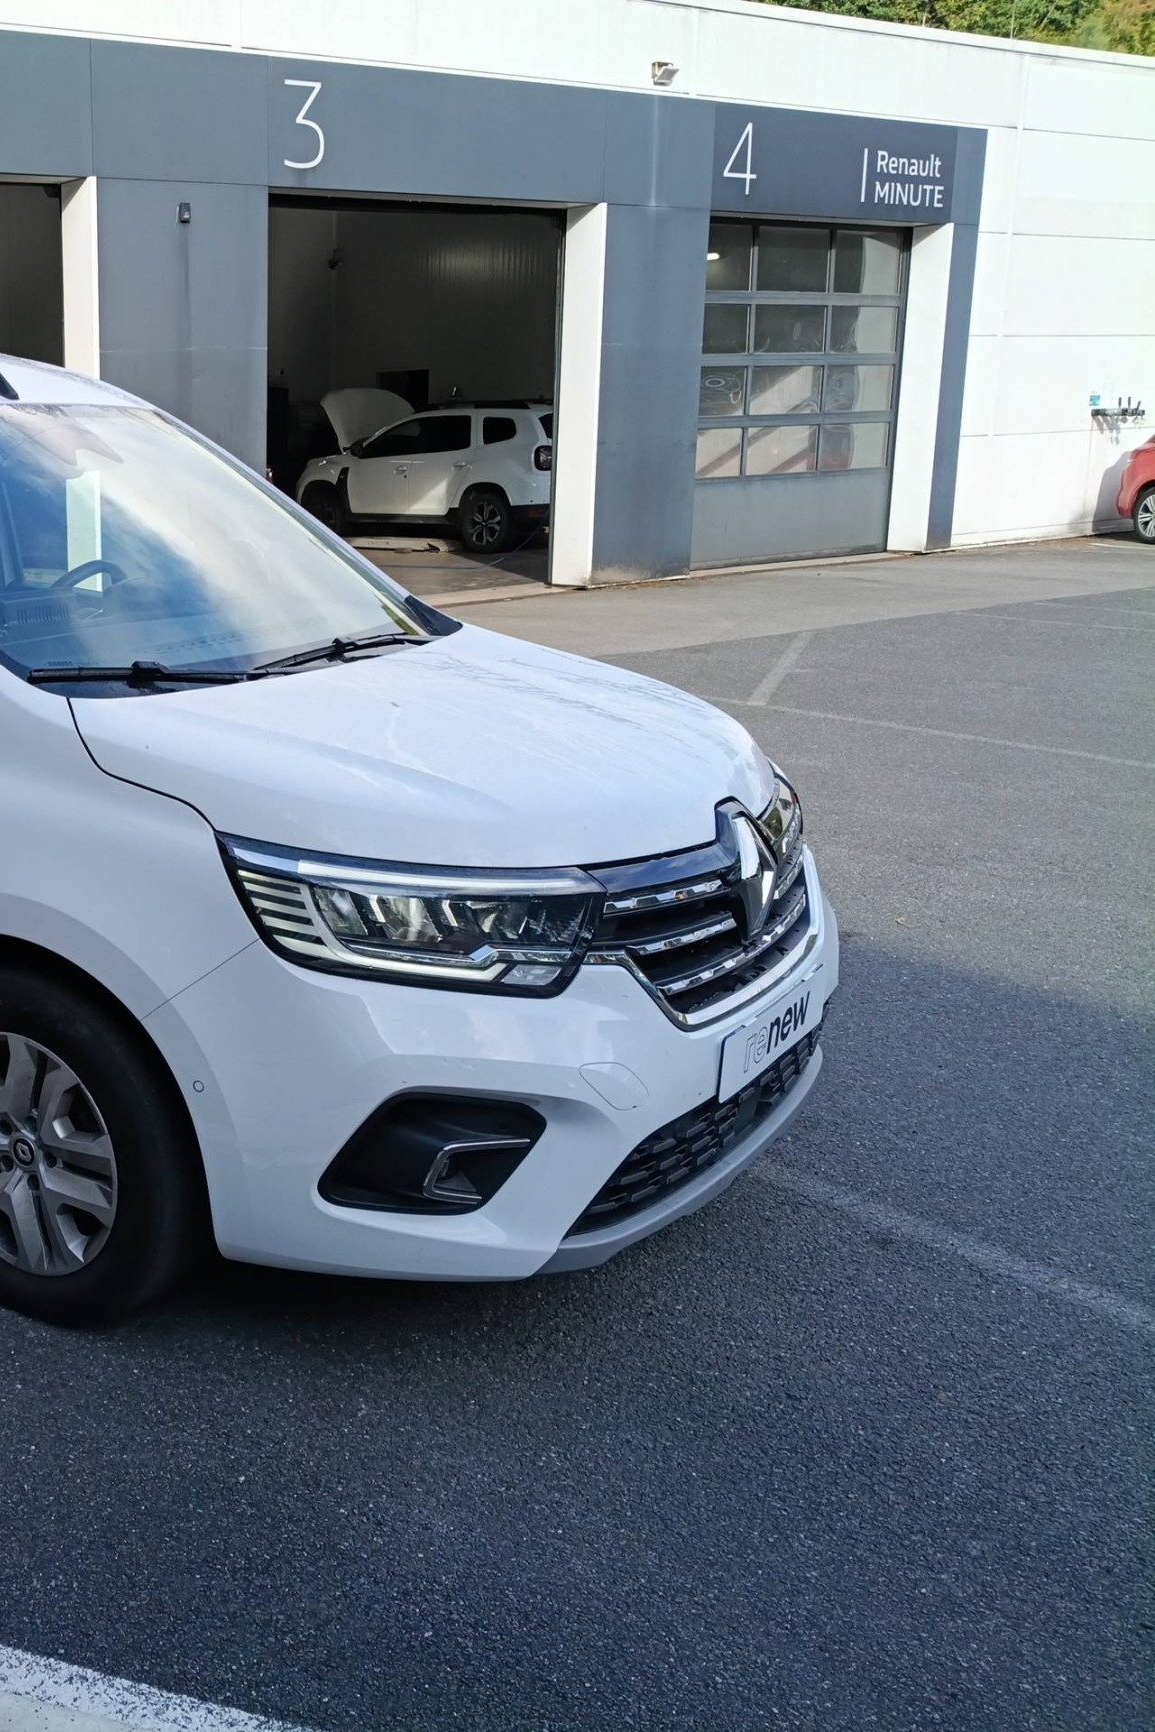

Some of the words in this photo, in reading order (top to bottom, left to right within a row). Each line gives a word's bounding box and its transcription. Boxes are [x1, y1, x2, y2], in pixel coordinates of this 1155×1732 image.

[283, 78, 325, 169] 3
[723, 122, 757, 195] 4
[874, 181, 945, 208] MINUTE
[877, 150, 942, 178] Renault
[743, 990, 810, 1073] renew
